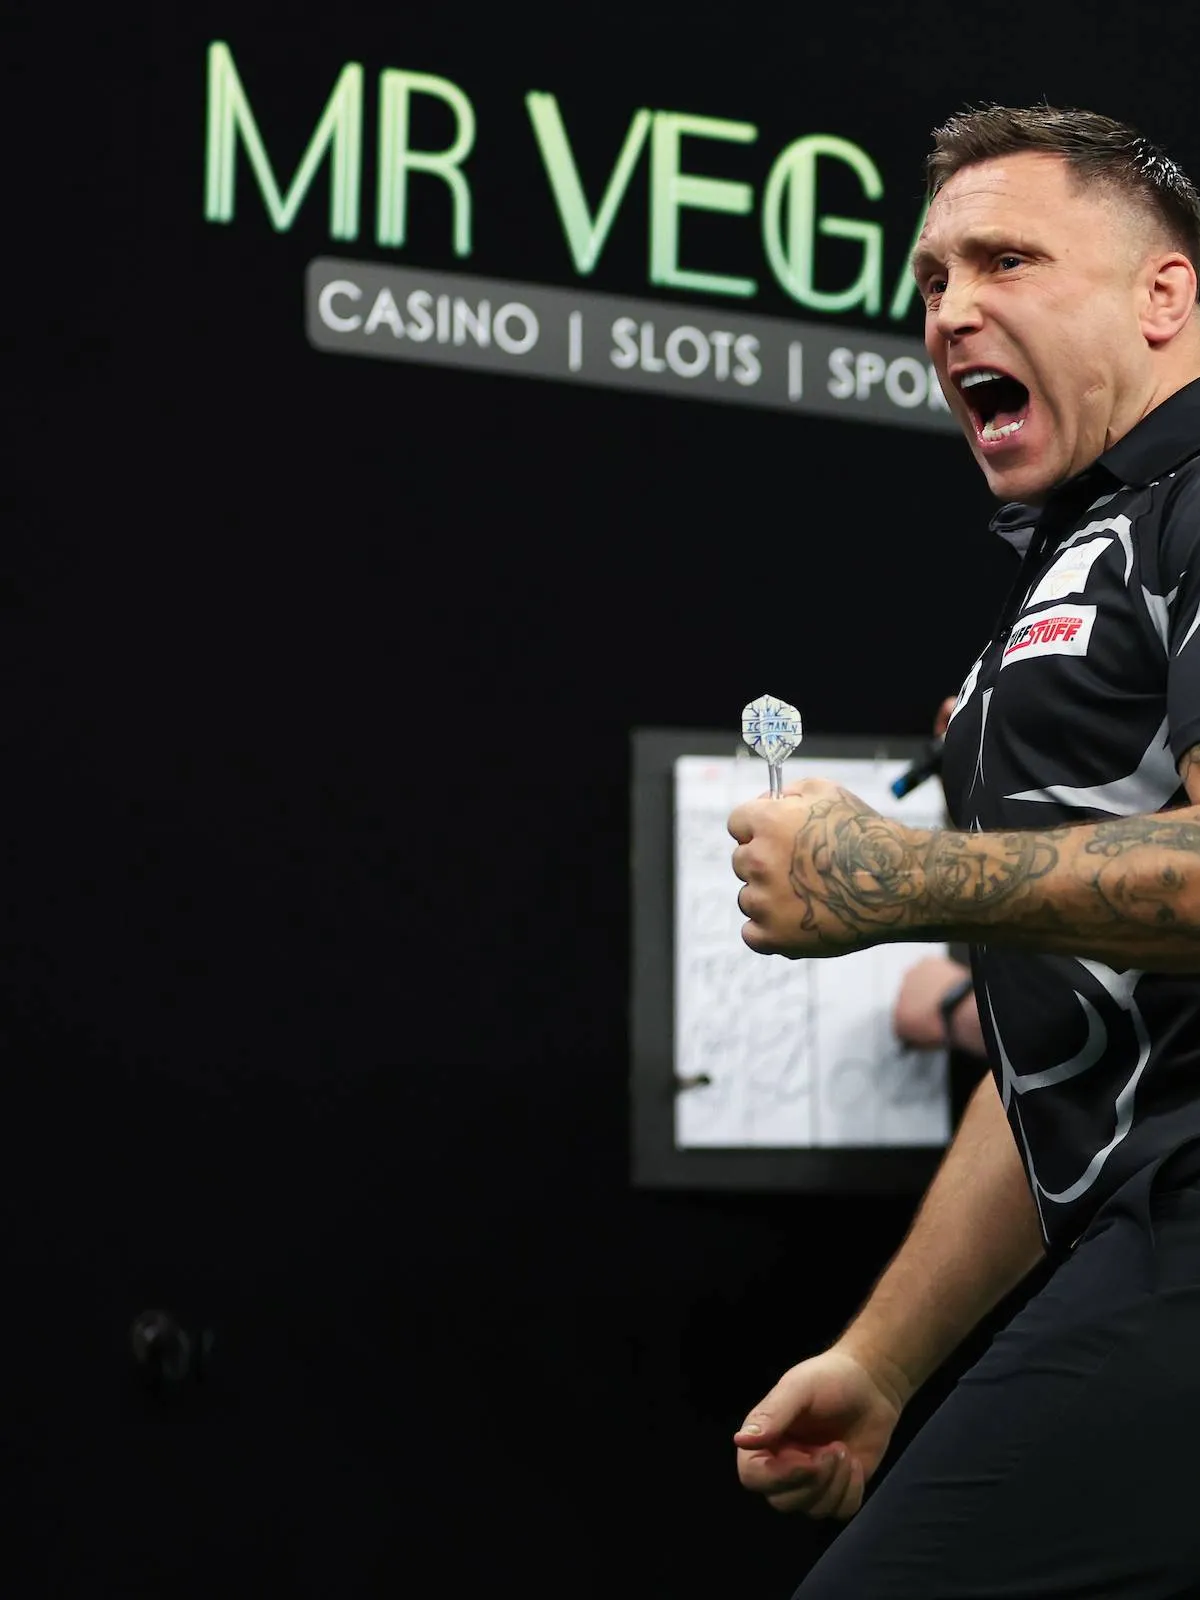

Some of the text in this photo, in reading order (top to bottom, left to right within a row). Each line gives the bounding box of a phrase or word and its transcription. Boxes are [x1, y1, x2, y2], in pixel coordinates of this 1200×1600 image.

[204, 40, 477, 258] MR
[317, 279, 540, 356] CASINO
[609, 317, 763, 386] SLOTS
